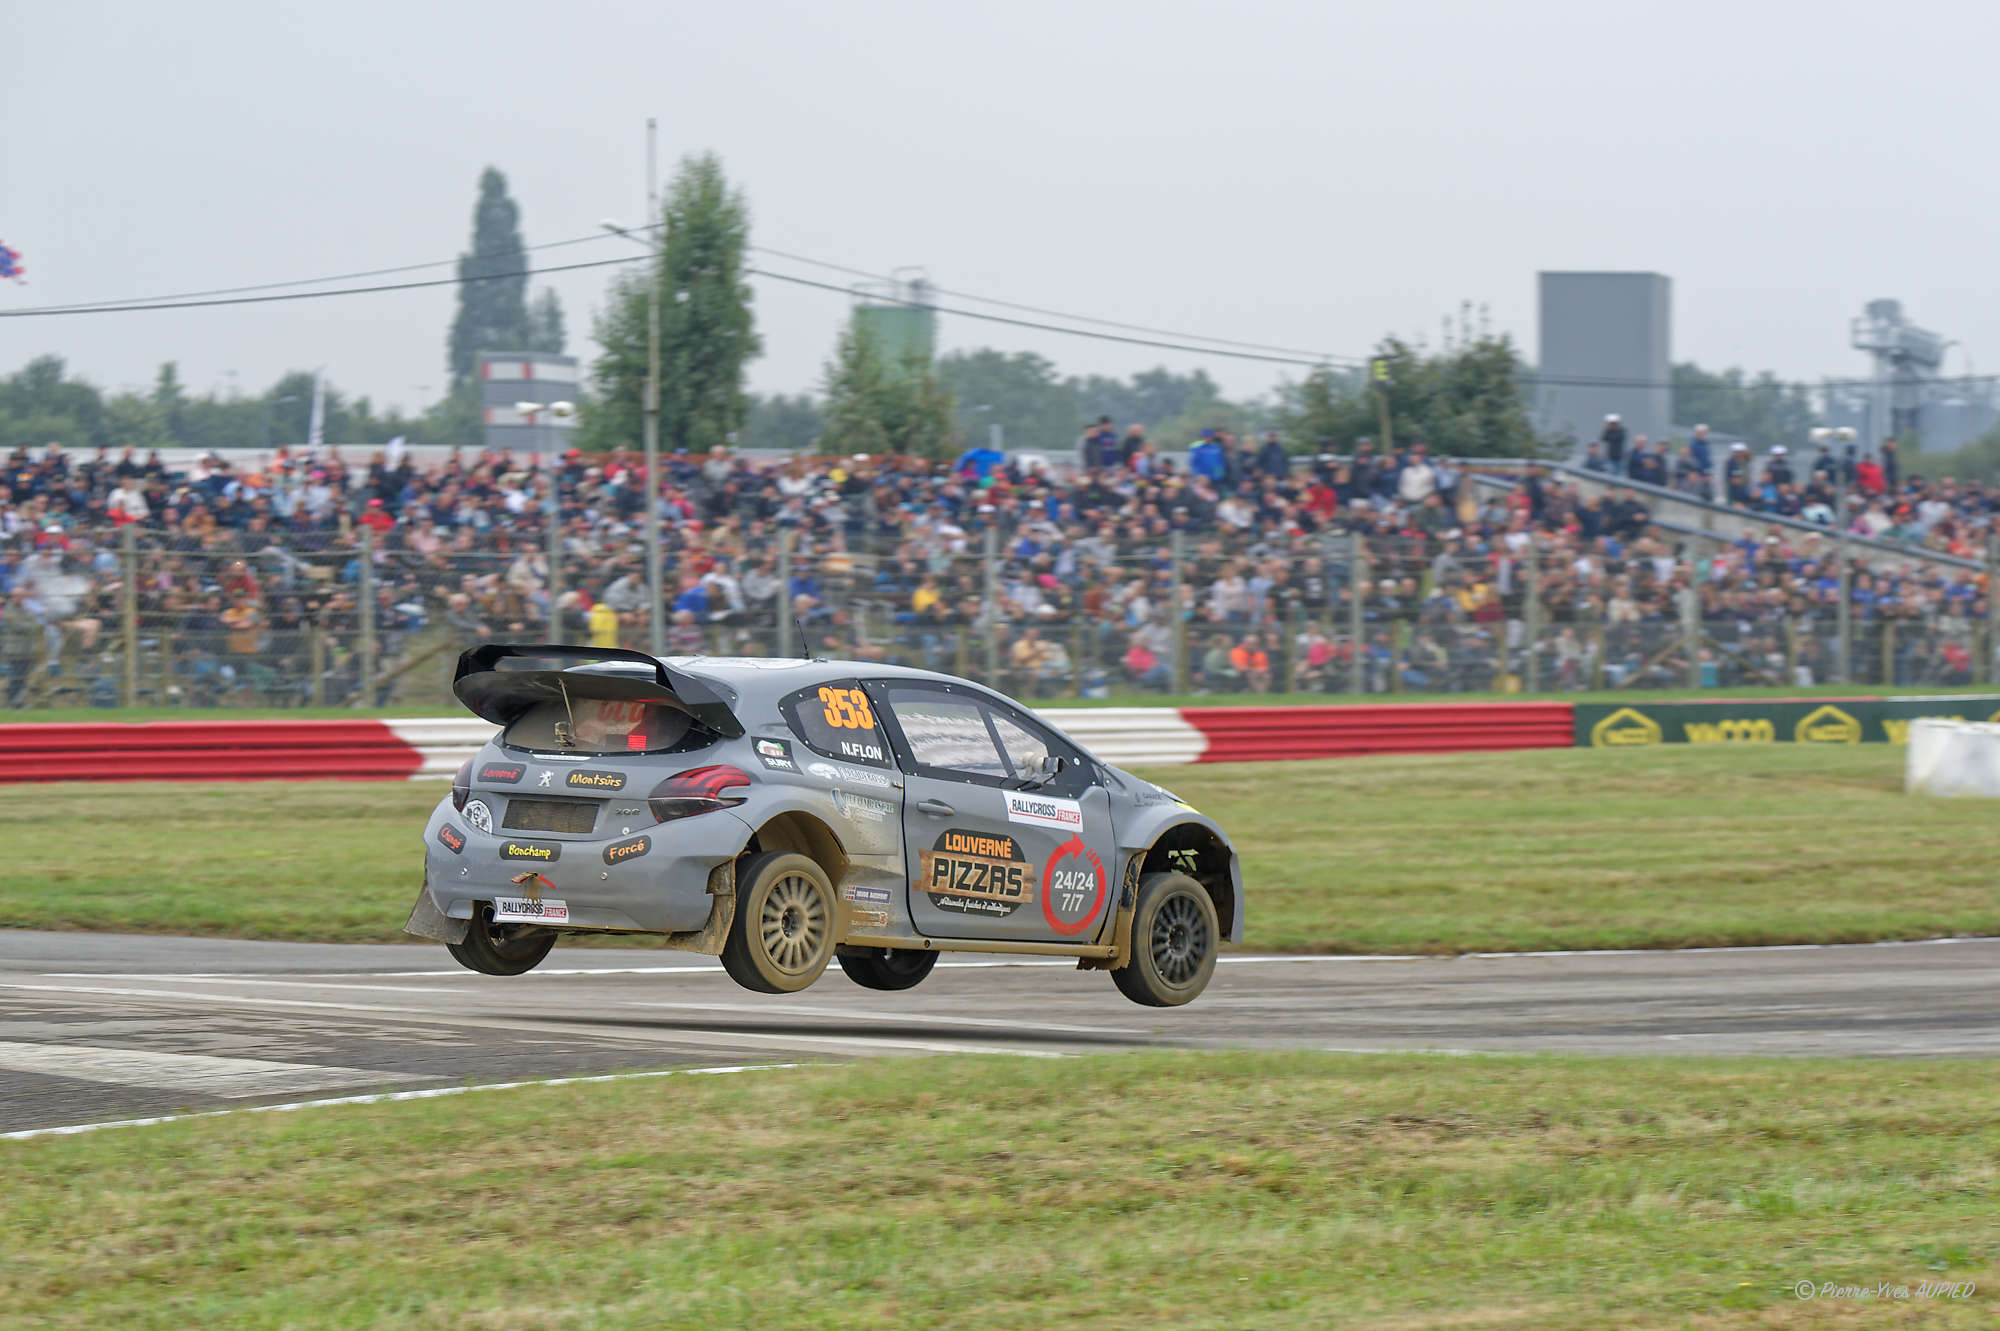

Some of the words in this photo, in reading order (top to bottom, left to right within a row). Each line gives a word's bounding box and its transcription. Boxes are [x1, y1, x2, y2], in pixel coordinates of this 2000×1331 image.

[818, 688, 874, 729] 353
[841, 741, 882, 760] N.FLON
[569, 774, 622, 787] Montsûrs
[1012, 799, 1056, 817] RALLYCROSS
[1058, 811, 1080, 824] FRANCE
[508, 844, 551, 860] Bonchamp
[609, 841, 646, 859] Forcé
[945, 832, 1012, 858] LOUVERNÉ
[932, 858, 1022, 897] PIZZAS
[1055, 871, 1094, 891] 24/24
[1062, 893, 1084, 912] 7/7
